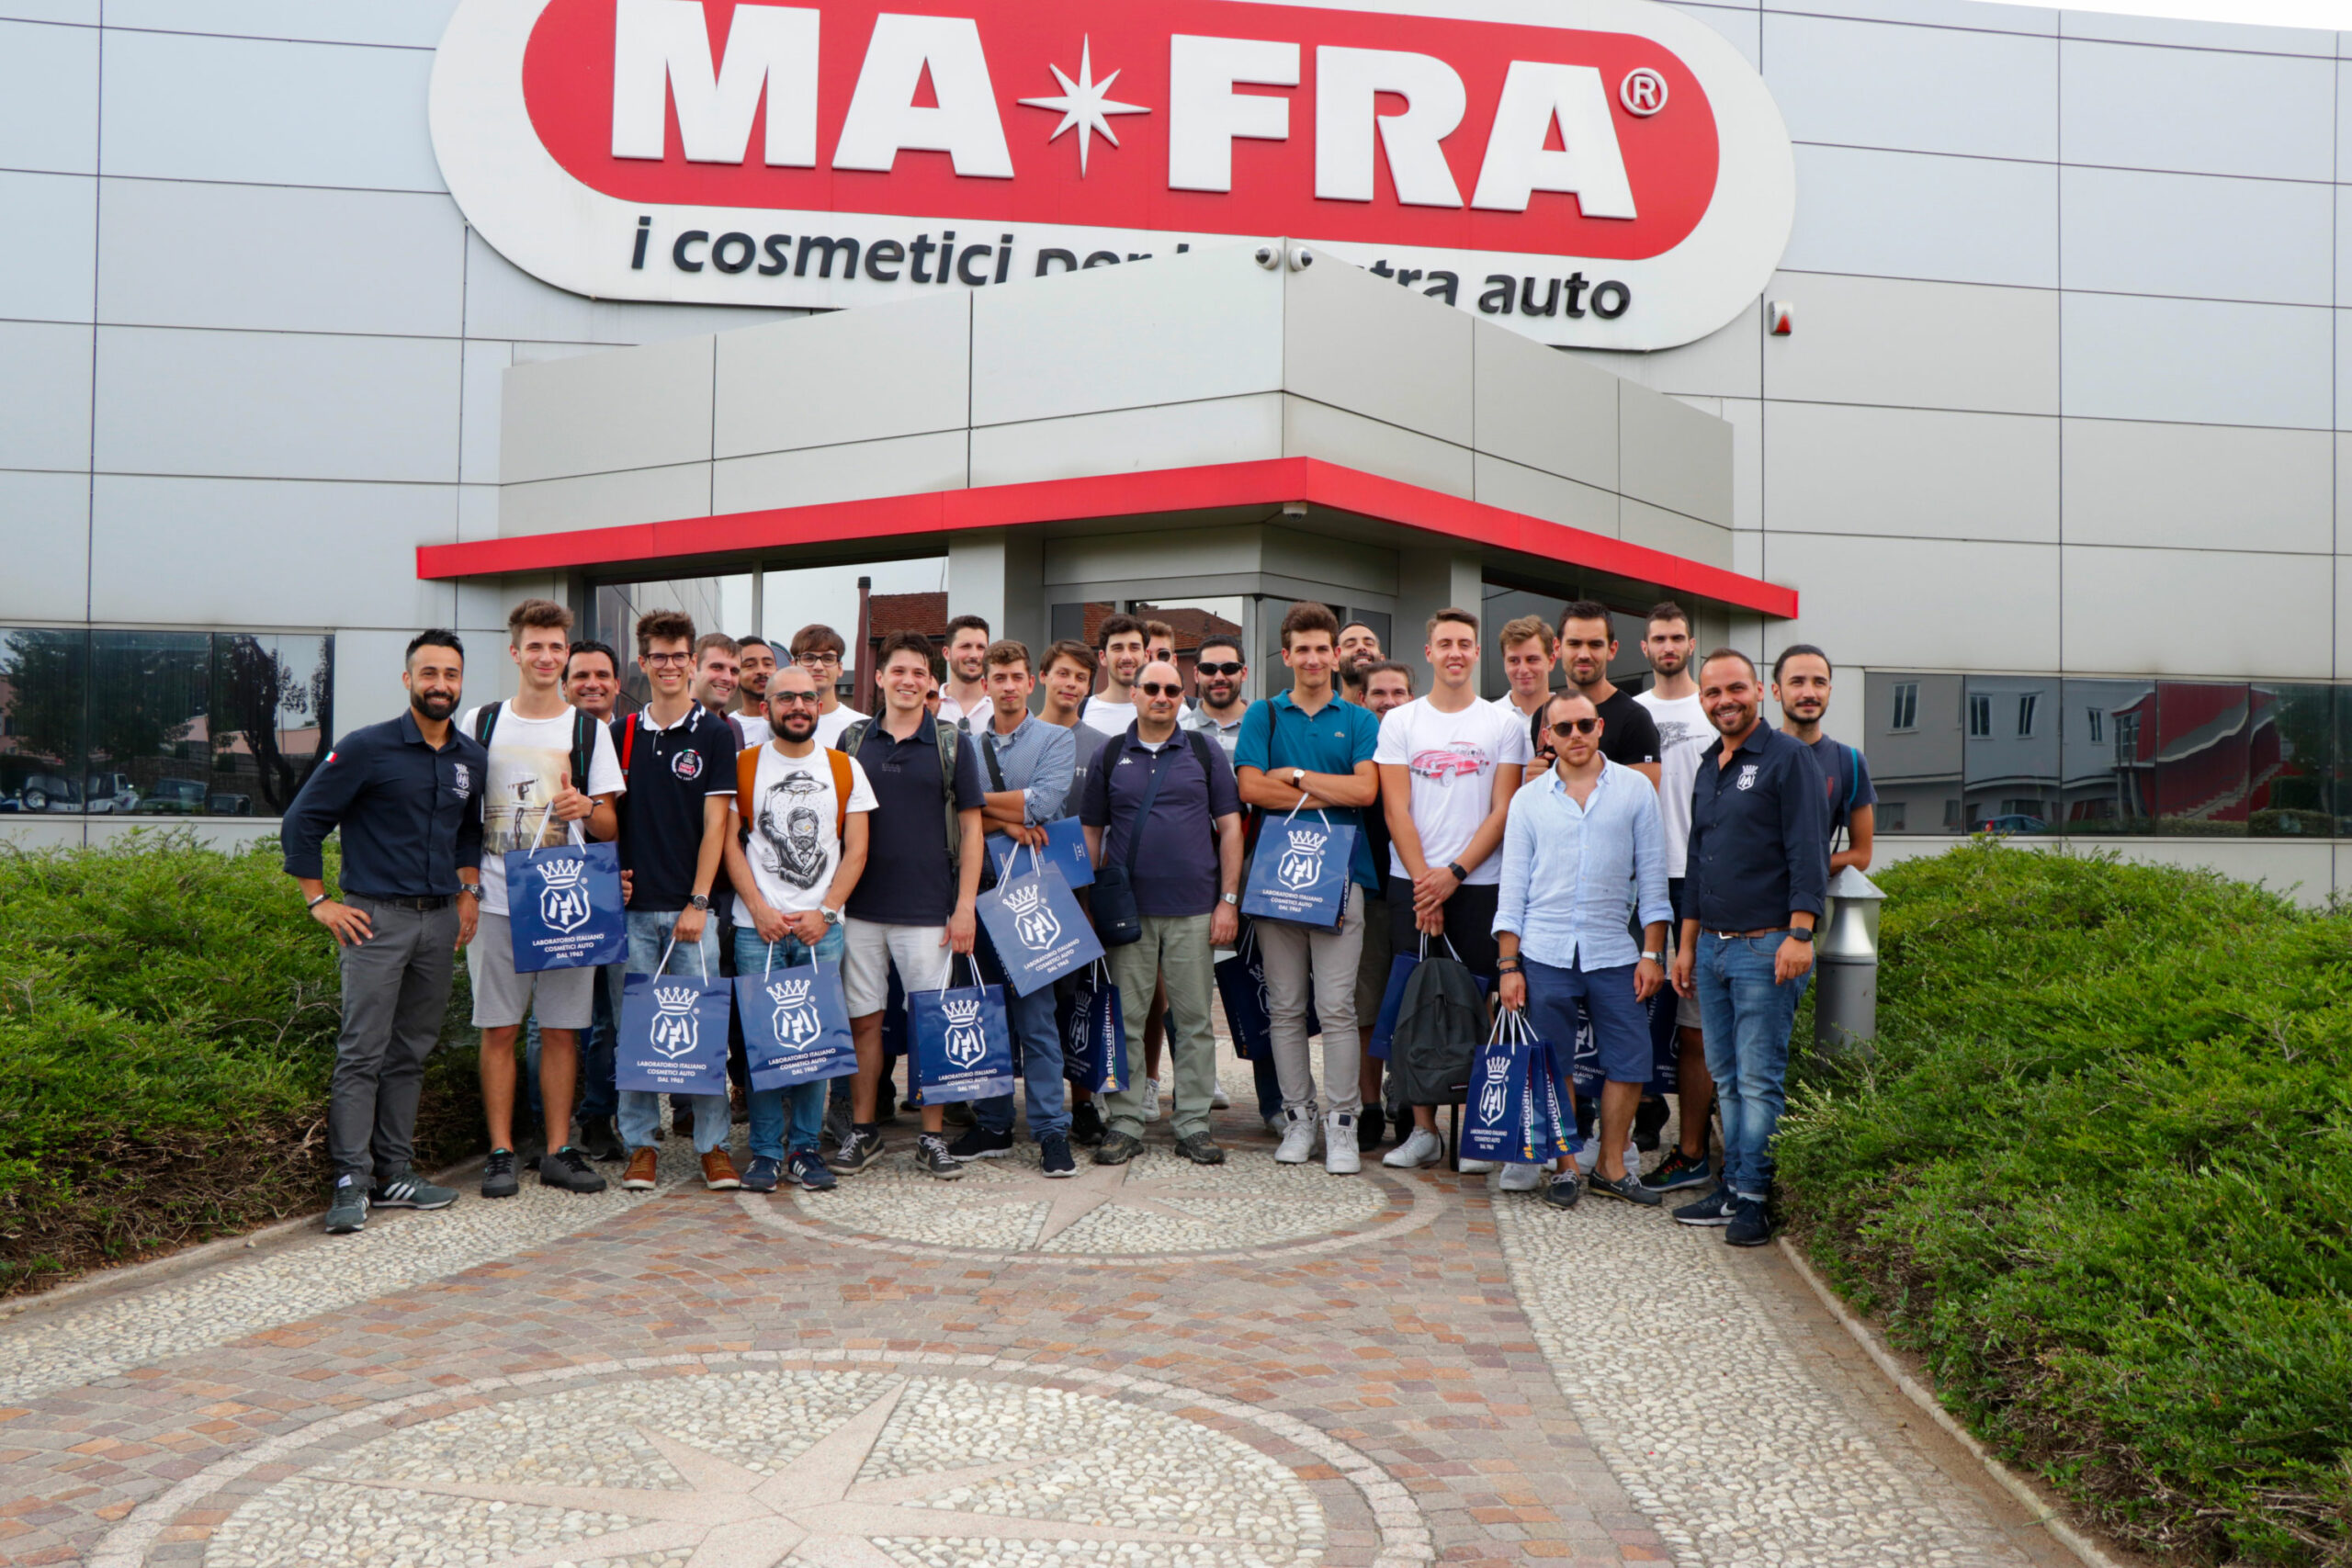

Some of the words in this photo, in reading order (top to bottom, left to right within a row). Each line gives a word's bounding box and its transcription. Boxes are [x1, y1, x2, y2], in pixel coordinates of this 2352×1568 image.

[612, 0, 1014, 178] MA
[1168, 33, 1638, 220] FRA
[630, 216, 651, 270] i
[672, 230, 1013, 287] cosmetici
[1477, 271, 1632, 319] auto
[1262, 889, 1298, 899] LABORATORIO
[1299, 894, 1323, 903] ITALIANO
[1271, 897, 1297, 906] COSMETICI
[532, 936, 575, 946] LABORATORIO
[576, 933, 605, 942] ITALIANO
[544, 943, 576, 952] COSMETICI
[1023, 950, 1057, 970] LABORATORIO
[1057, 938, 1080, 953] ITALIANO
[1035, 956, 1060, 971] COSMETICI
[1060, 949, 1075, 959] AUTO
[768, 1053, 808, 1066] LABORATORIO
[809, 1048, 836, 1057] ITALIANO
[637, 1061, 679, 1069] LABORATORIO
[679, 1062, 707, 1070] ITALIANO
[779, 1060, 810, 1070] COSMETICI
[647, 1068, 678, 1077] COSMETICI
[938, 1071, 974, 1081] LABORATORIO
